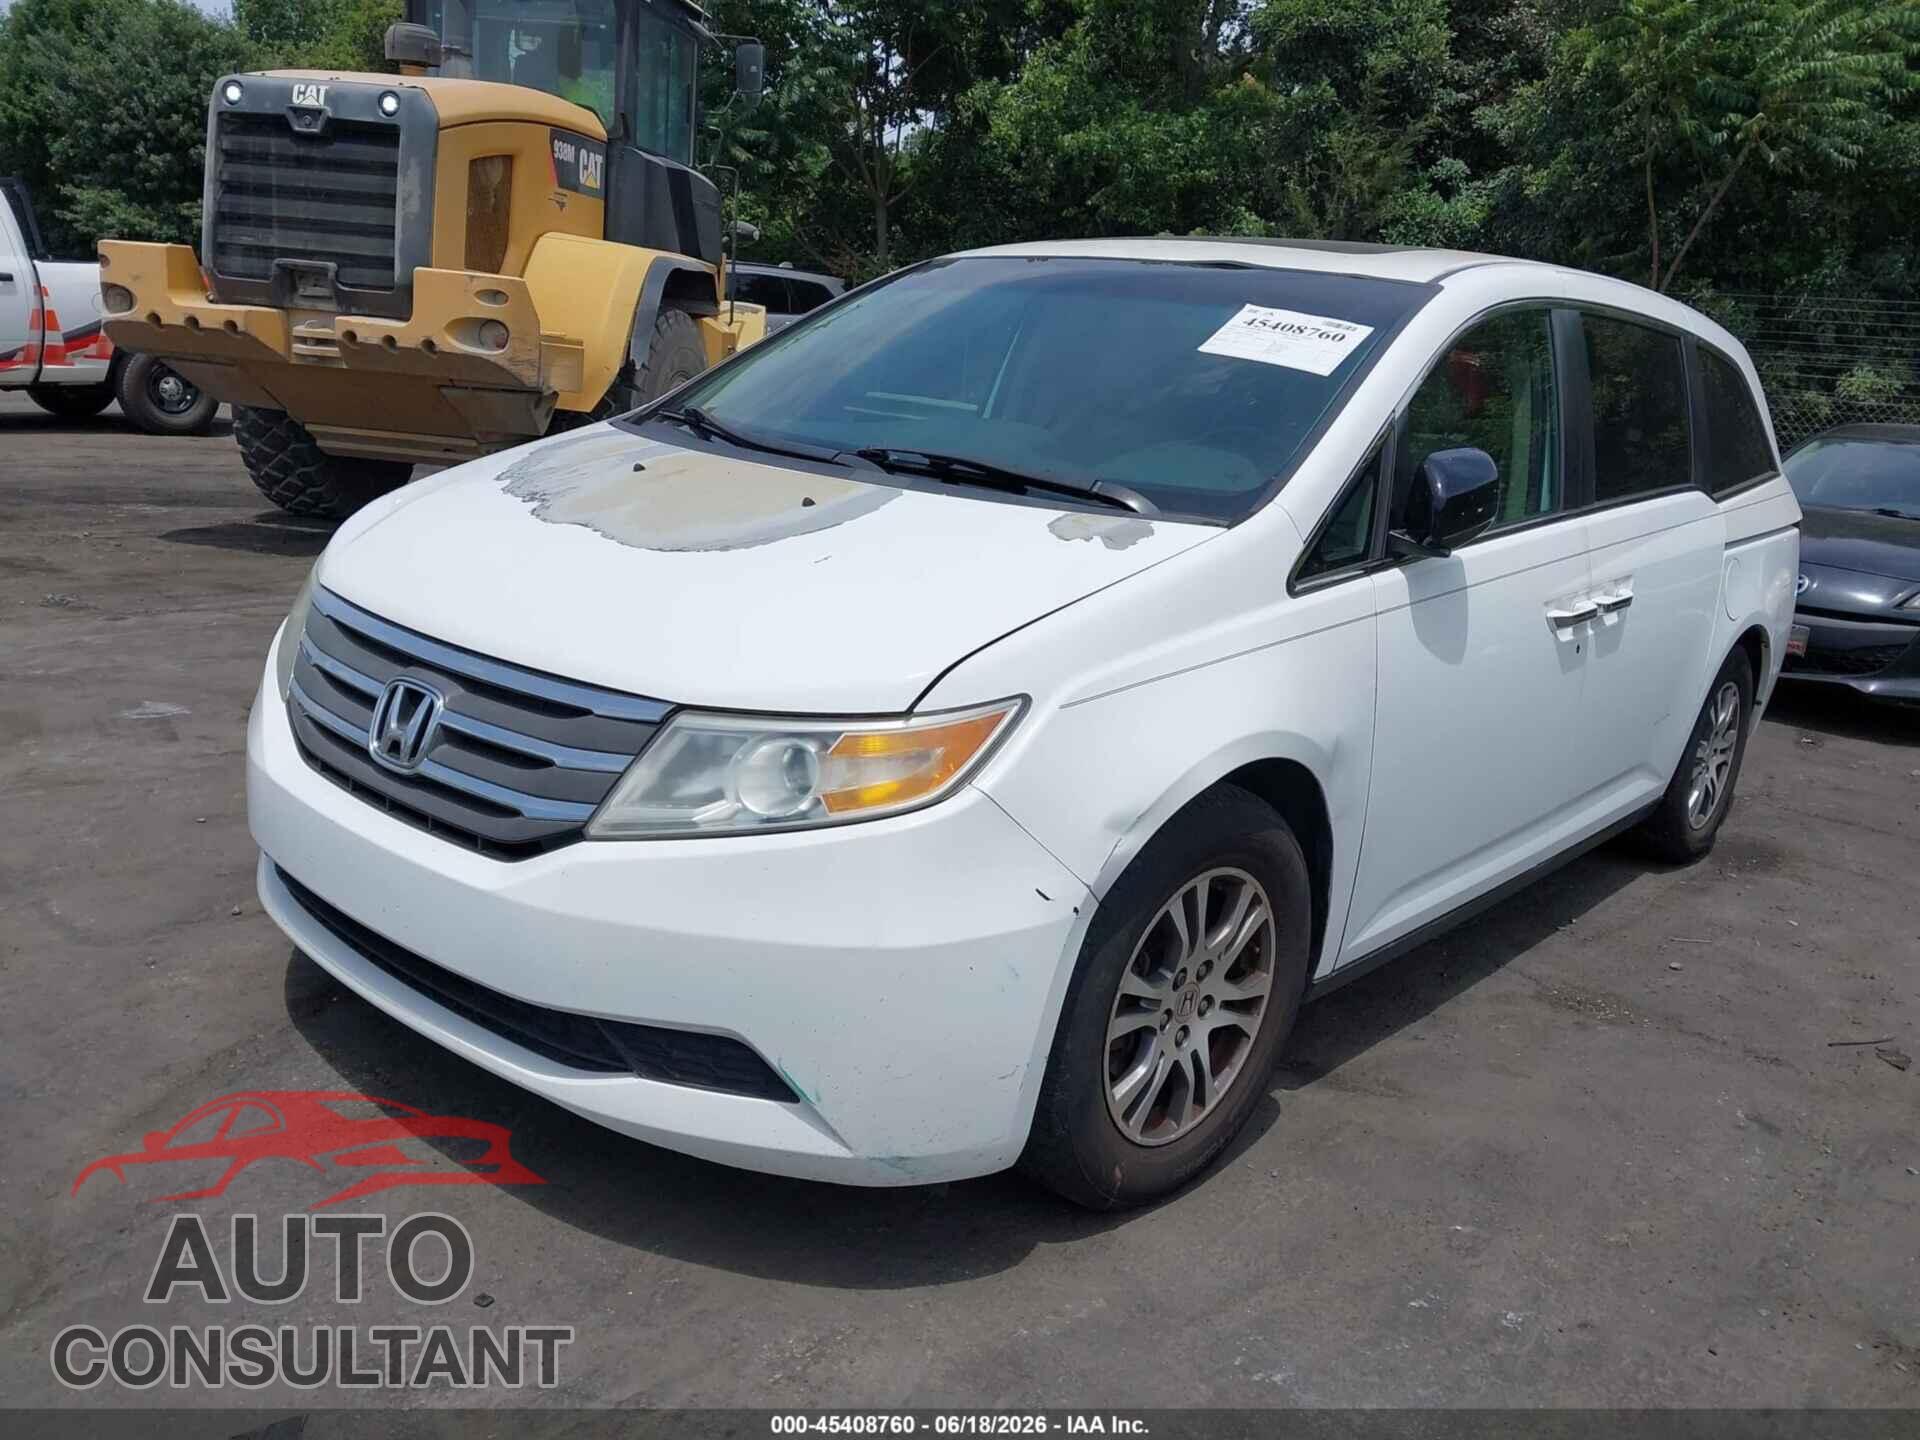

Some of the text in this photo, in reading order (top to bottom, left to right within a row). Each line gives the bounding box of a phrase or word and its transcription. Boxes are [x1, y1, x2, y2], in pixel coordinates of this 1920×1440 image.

[292, 84, 329, 106] CAT
[553, 138, 576, 163] 938M
[579, 148, 603, 189] CAT
[1242, 317, 1347, 343] 45408760
